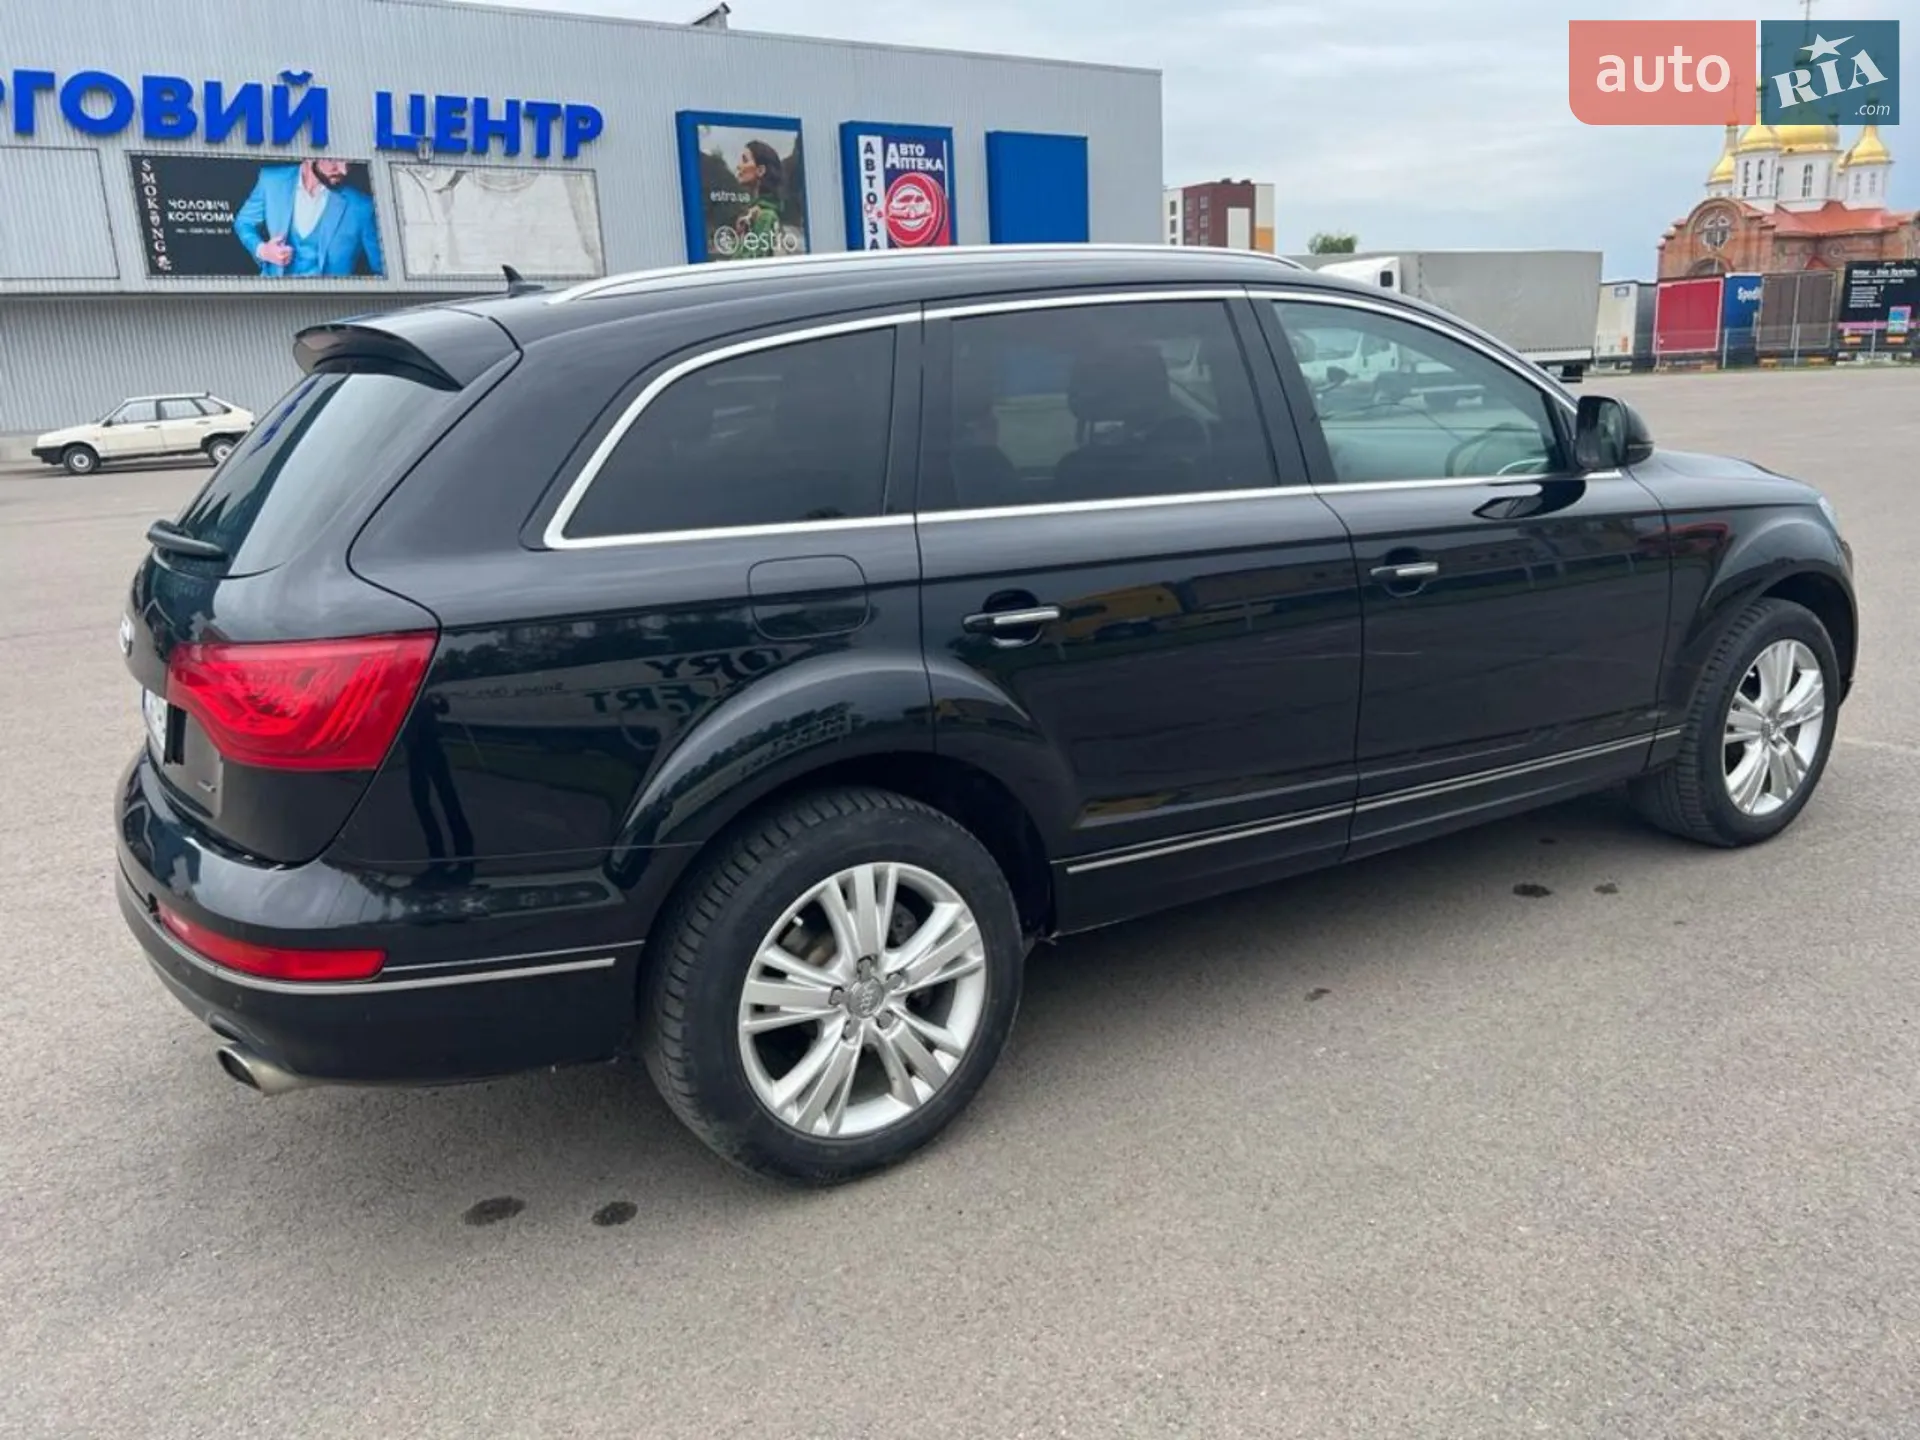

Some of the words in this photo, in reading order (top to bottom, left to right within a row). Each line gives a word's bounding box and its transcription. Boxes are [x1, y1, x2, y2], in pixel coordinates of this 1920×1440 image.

[0, 69, 329, 148] ГОВИЙ
[375, 91, 605, 160] ЦЕНТР
[168, 199, 230, 211] ЧОЛОВІЧІ
[168, 212, 234, 222] КОСТЮМИ
[744, 230, 798, 252] estro
